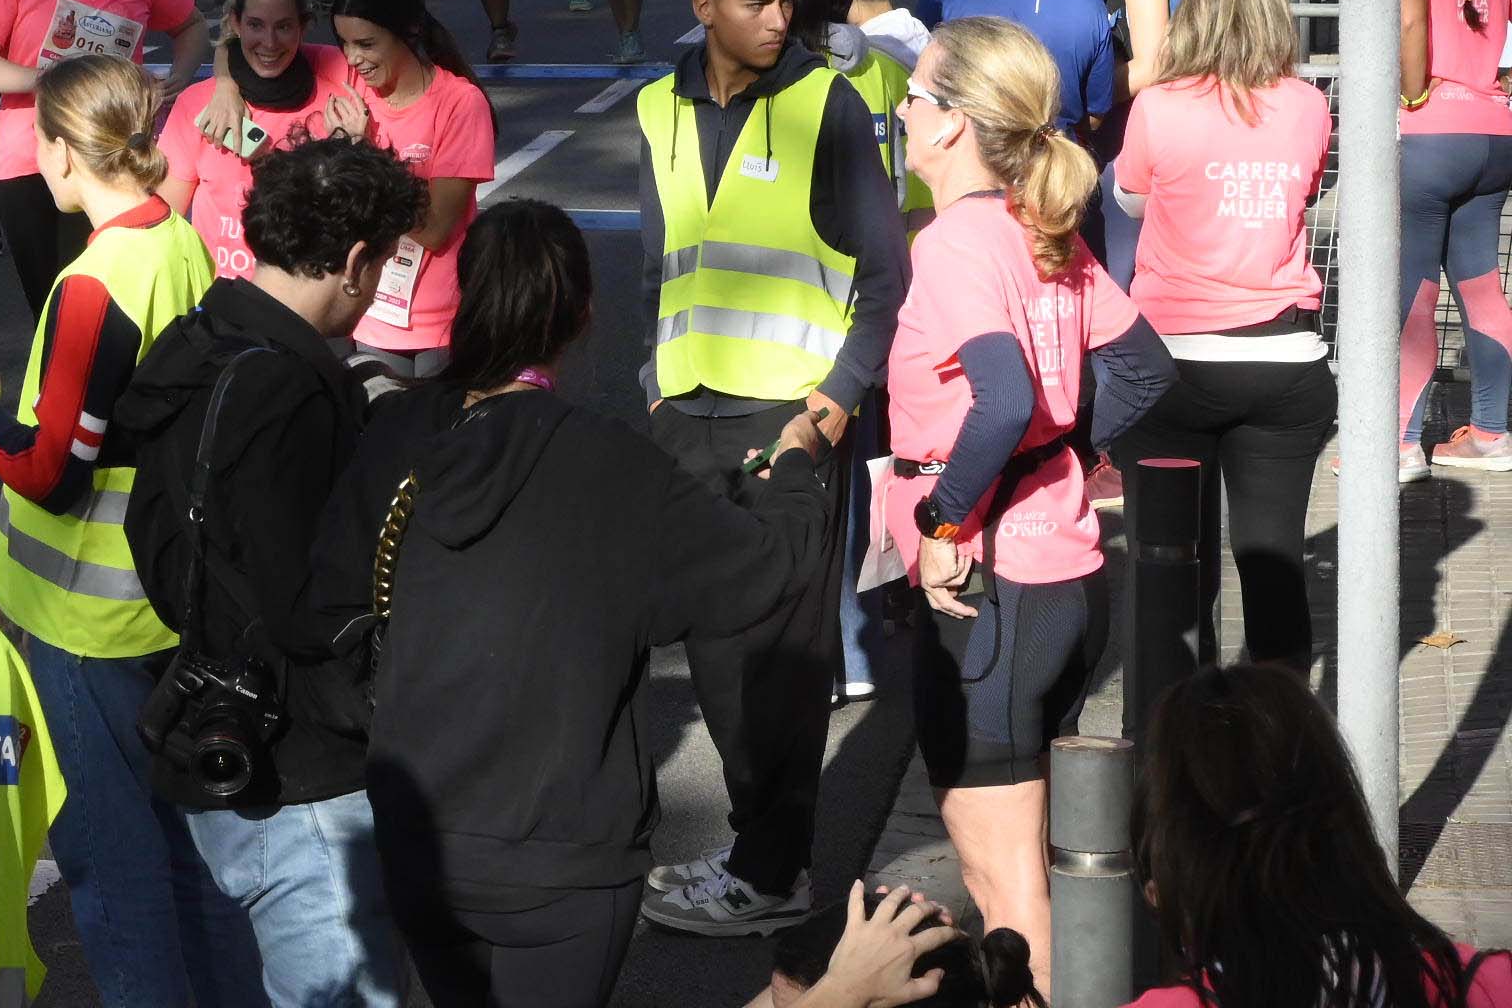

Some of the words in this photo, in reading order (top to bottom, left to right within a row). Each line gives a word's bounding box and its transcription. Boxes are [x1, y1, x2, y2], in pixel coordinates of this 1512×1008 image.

[76, 37, 105, 54] 016
[1205, 161, 1301, 181] CARRERA
[1223, 181, 1252, 199] DE
[1259, 181, 1285, 200] LA
[1217, 200, 1289, 220] MUJER
[235, 684, 258, 699] Canon
